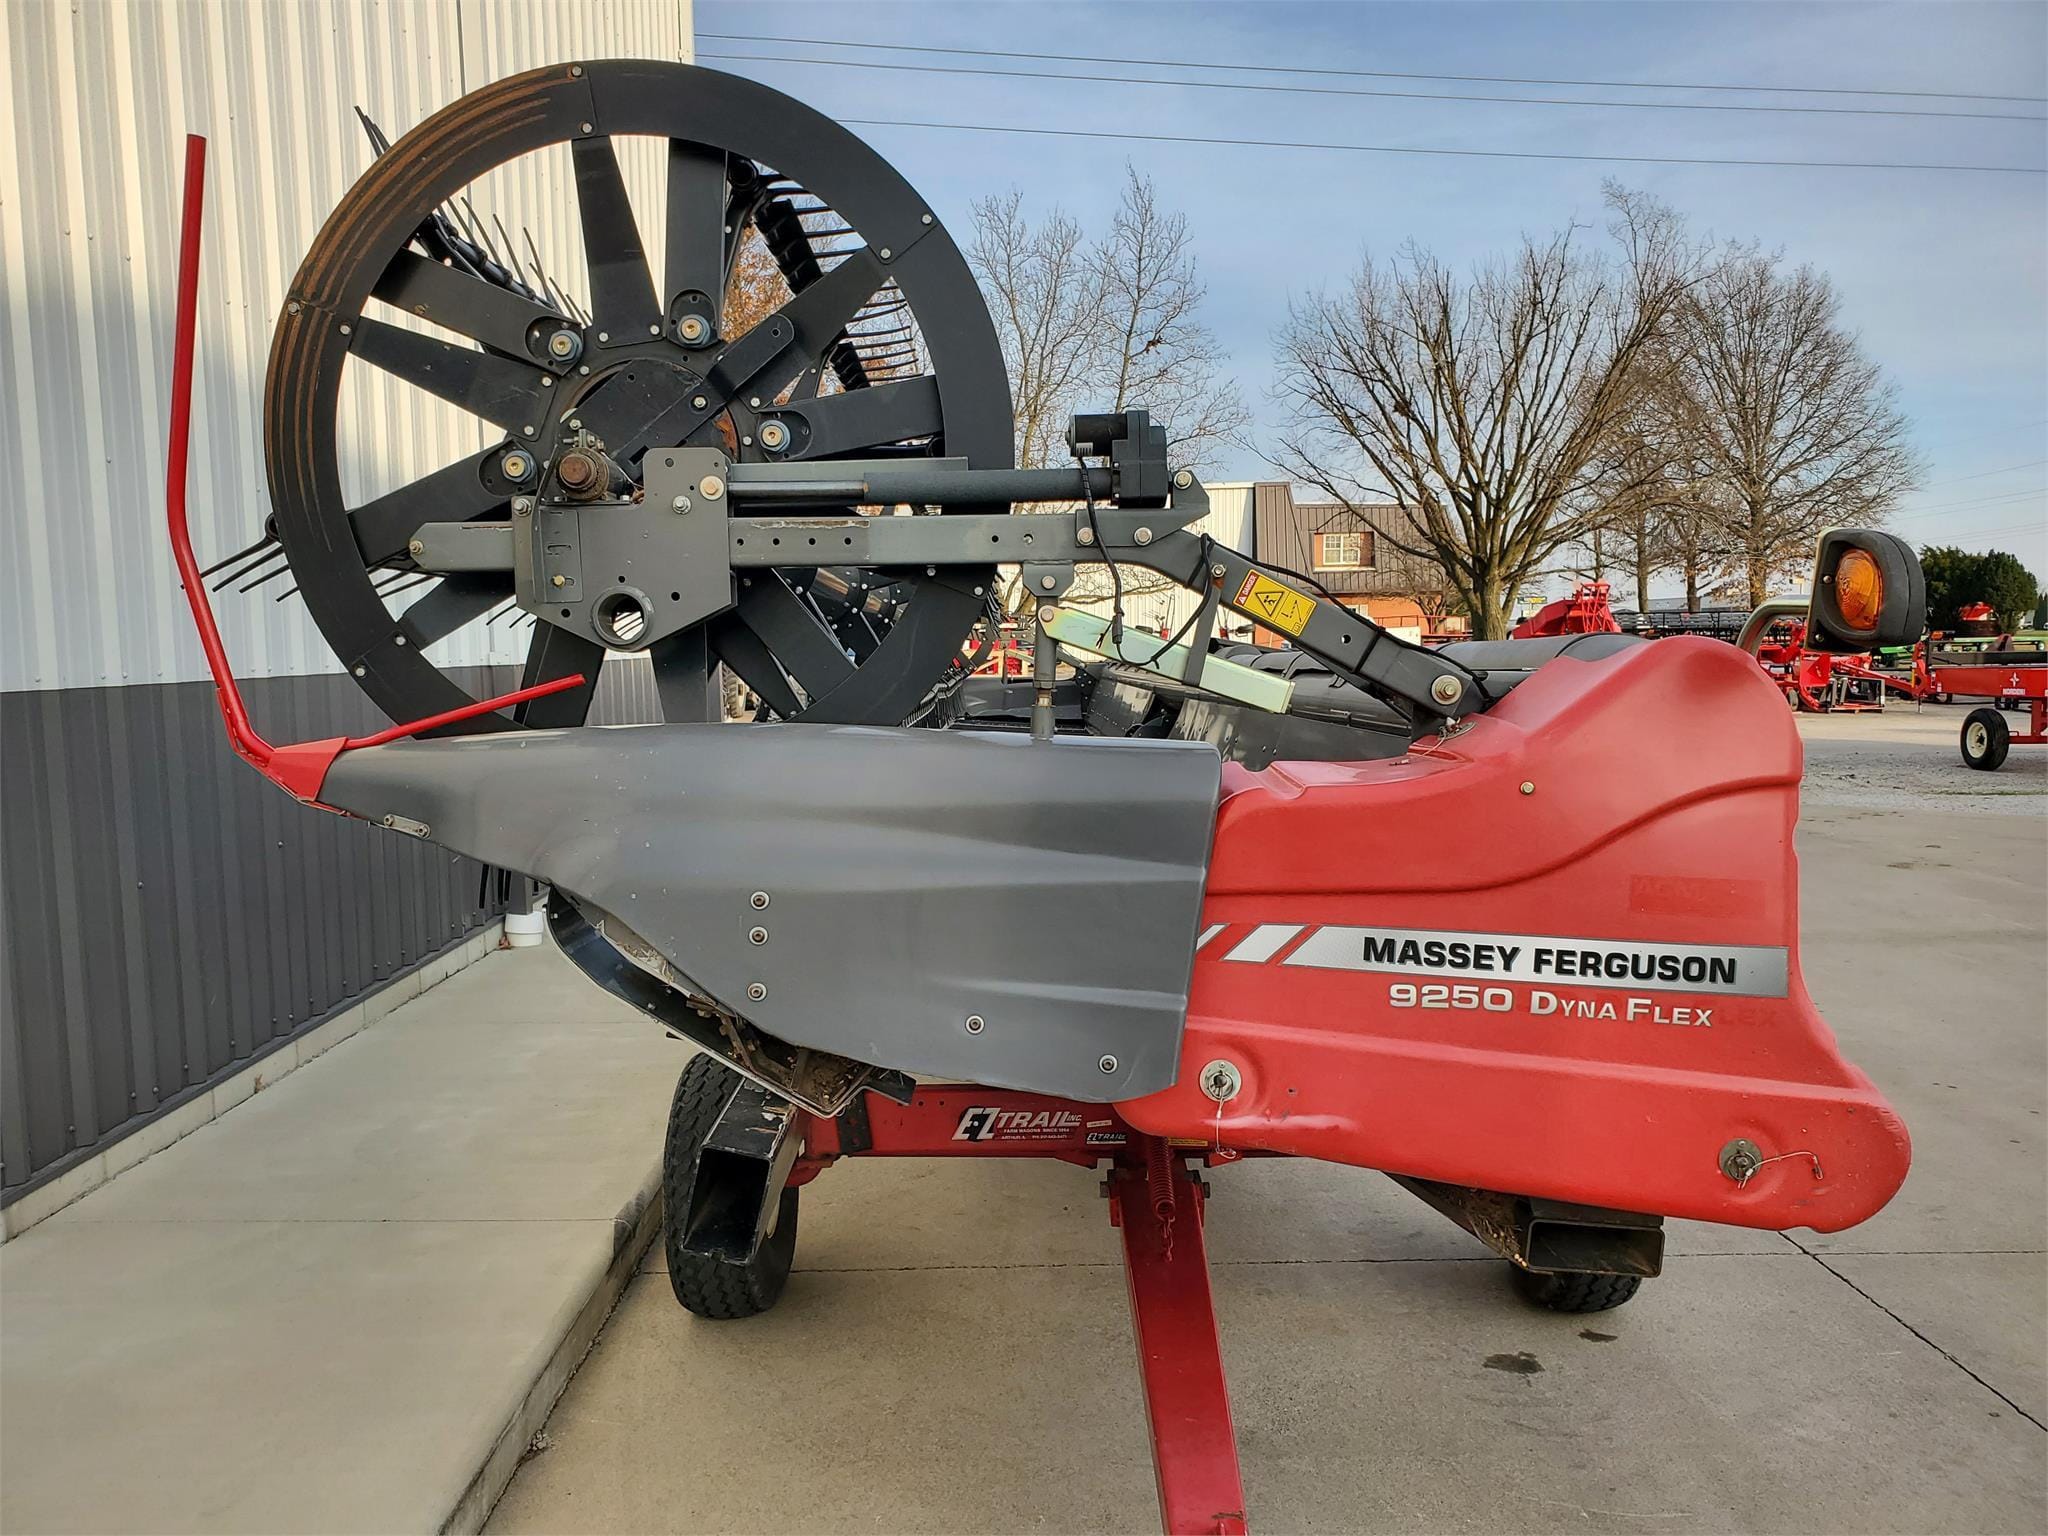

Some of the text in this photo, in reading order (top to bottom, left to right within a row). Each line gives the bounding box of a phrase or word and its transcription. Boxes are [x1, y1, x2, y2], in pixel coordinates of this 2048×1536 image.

[1242, 574, 1257, 595] DANGER
[1363, 936, 1737, 985] MASSEY FERGUSON
[1389, 983, 1514, 1012] 9250
[1626, 997, 1713, 1027] FLEX
